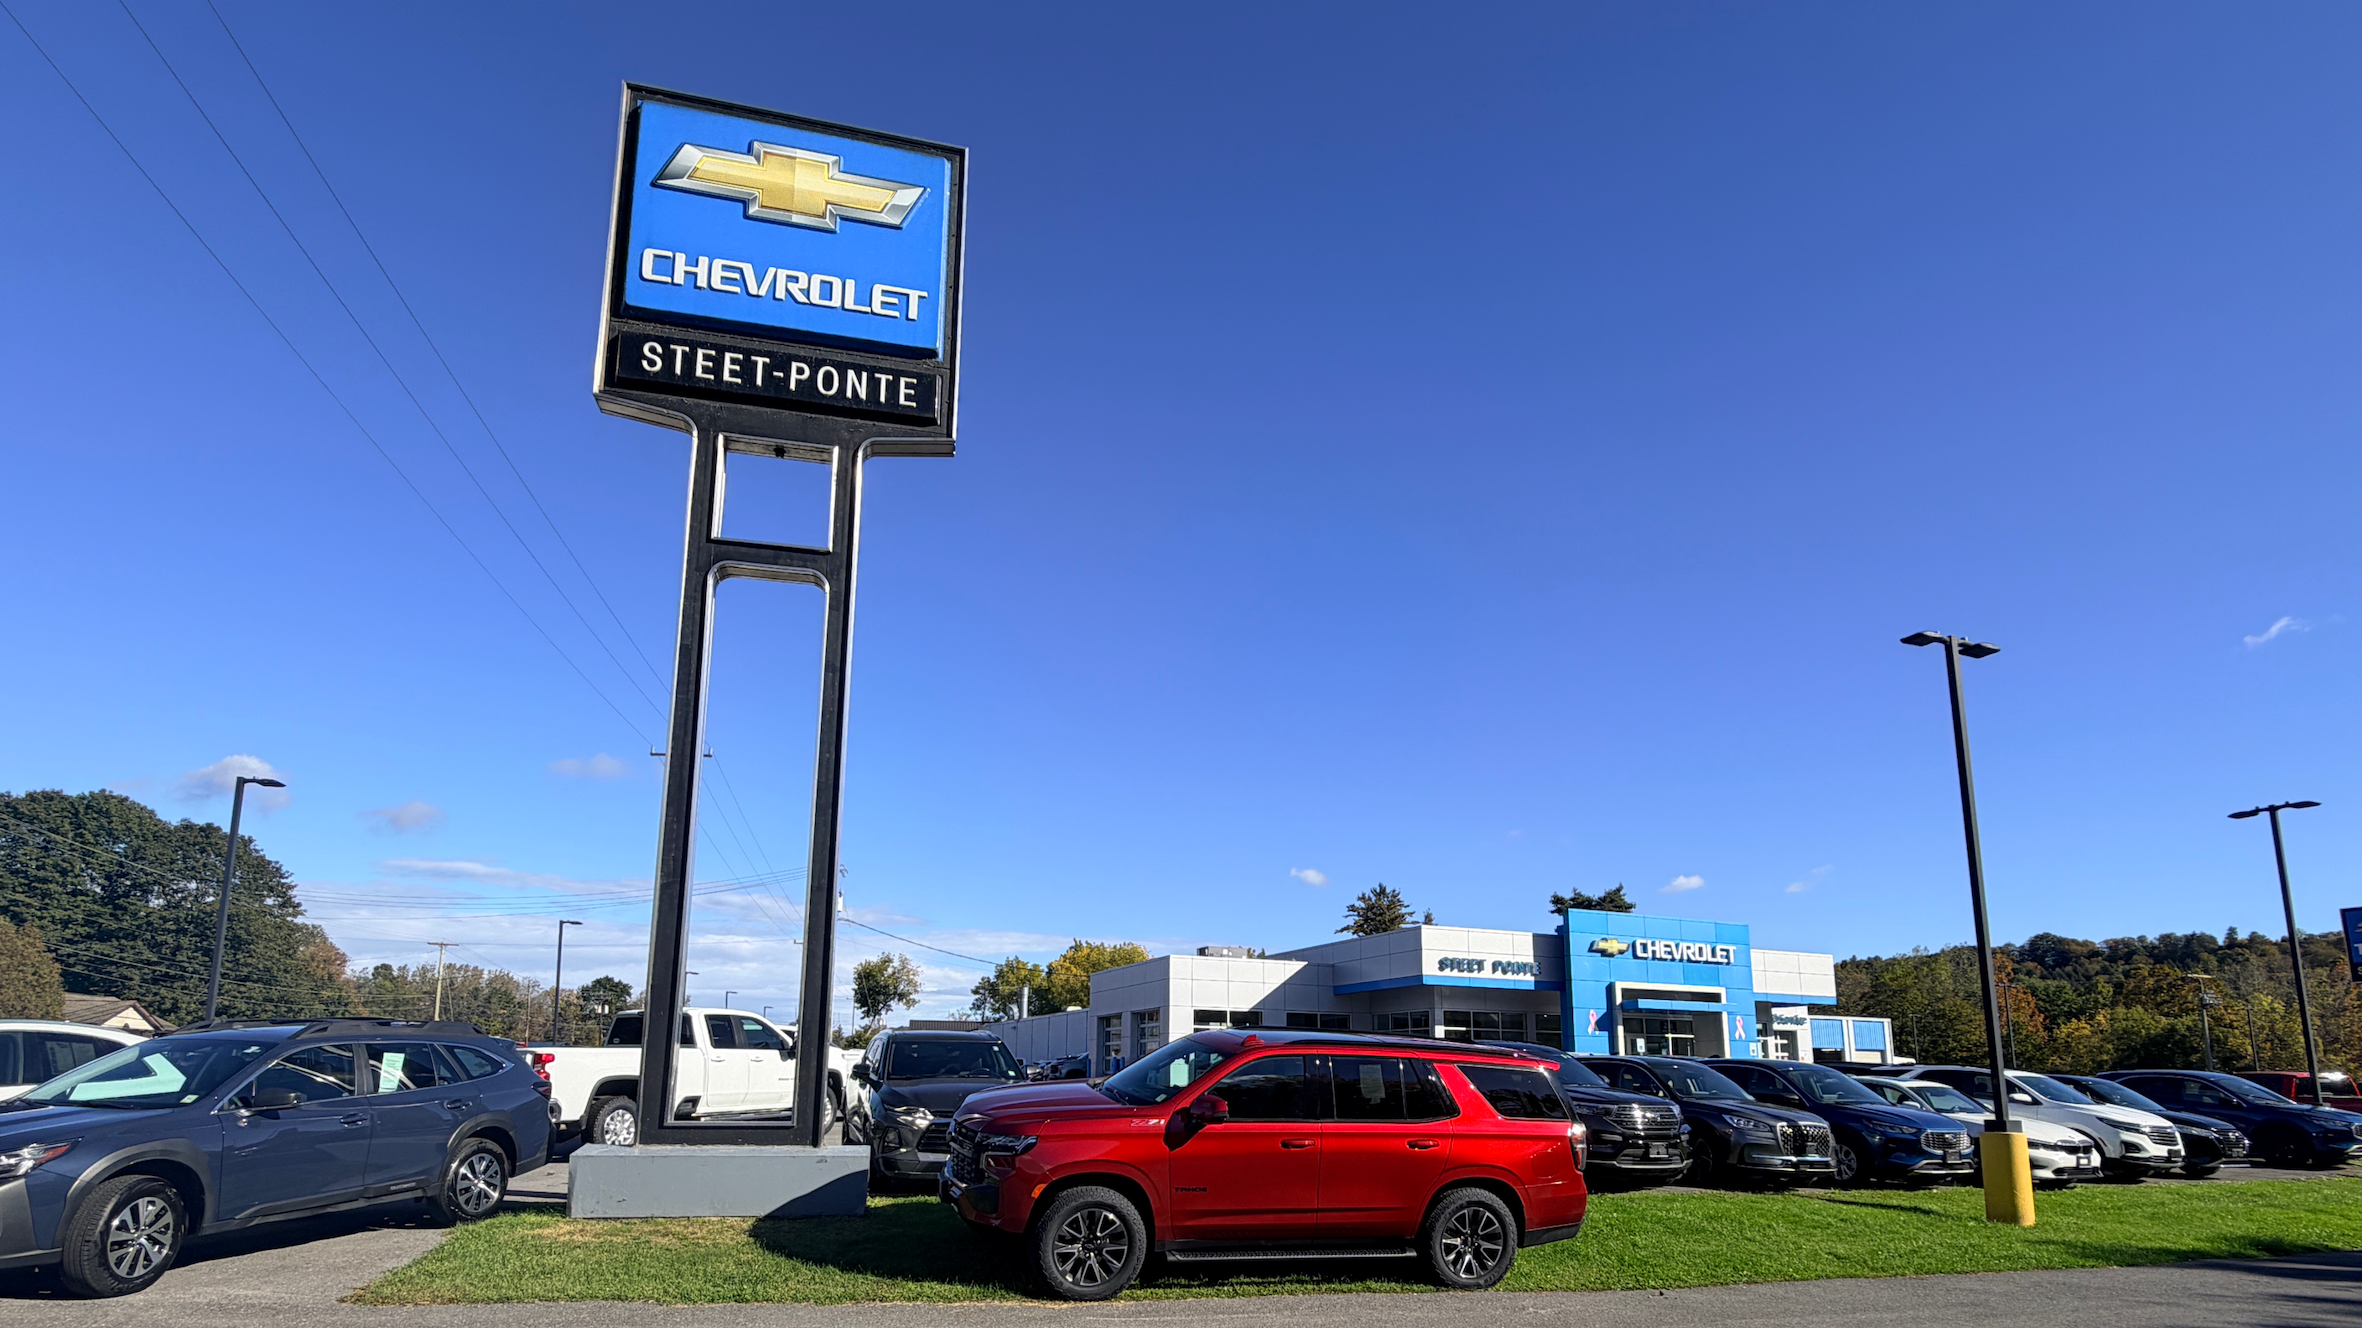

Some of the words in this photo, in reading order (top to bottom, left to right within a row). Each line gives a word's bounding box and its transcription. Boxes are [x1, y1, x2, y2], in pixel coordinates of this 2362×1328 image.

[641, 247, 928, 320] CHEVROLET
[641, 340, 918, 408] STEET-PONTE
[1438, 956, 1487, 974] STEET
[1633, 938, 1737, 965] CHEVROLET
